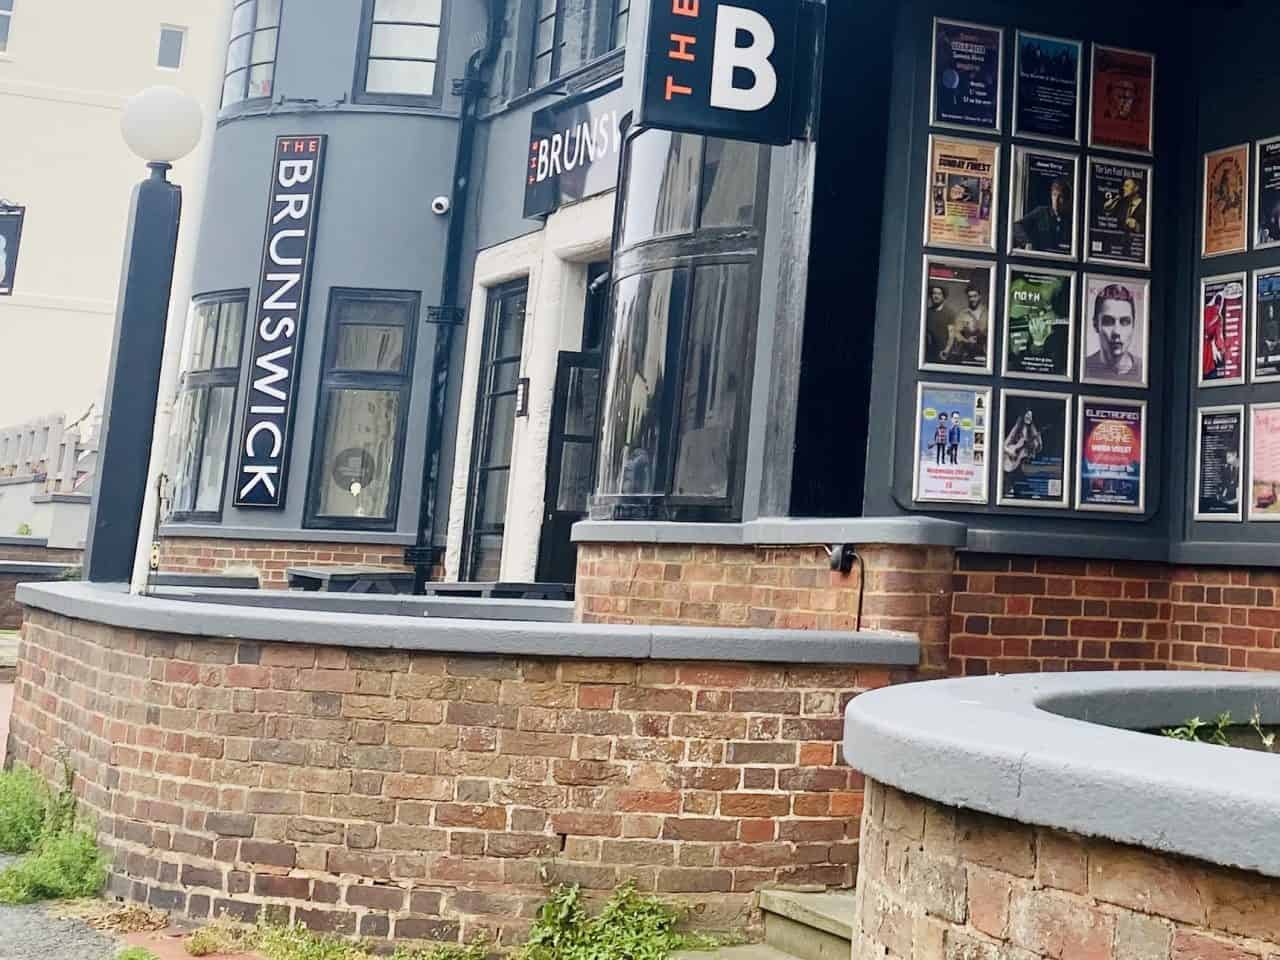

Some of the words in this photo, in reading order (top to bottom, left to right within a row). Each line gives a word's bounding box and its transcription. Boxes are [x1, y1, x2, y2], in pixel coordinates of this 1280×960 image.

[710, 3, 777, 112] B
[280, 139, 318, 153] THE
[240, 159, 314, 500] BRUNSWICK
